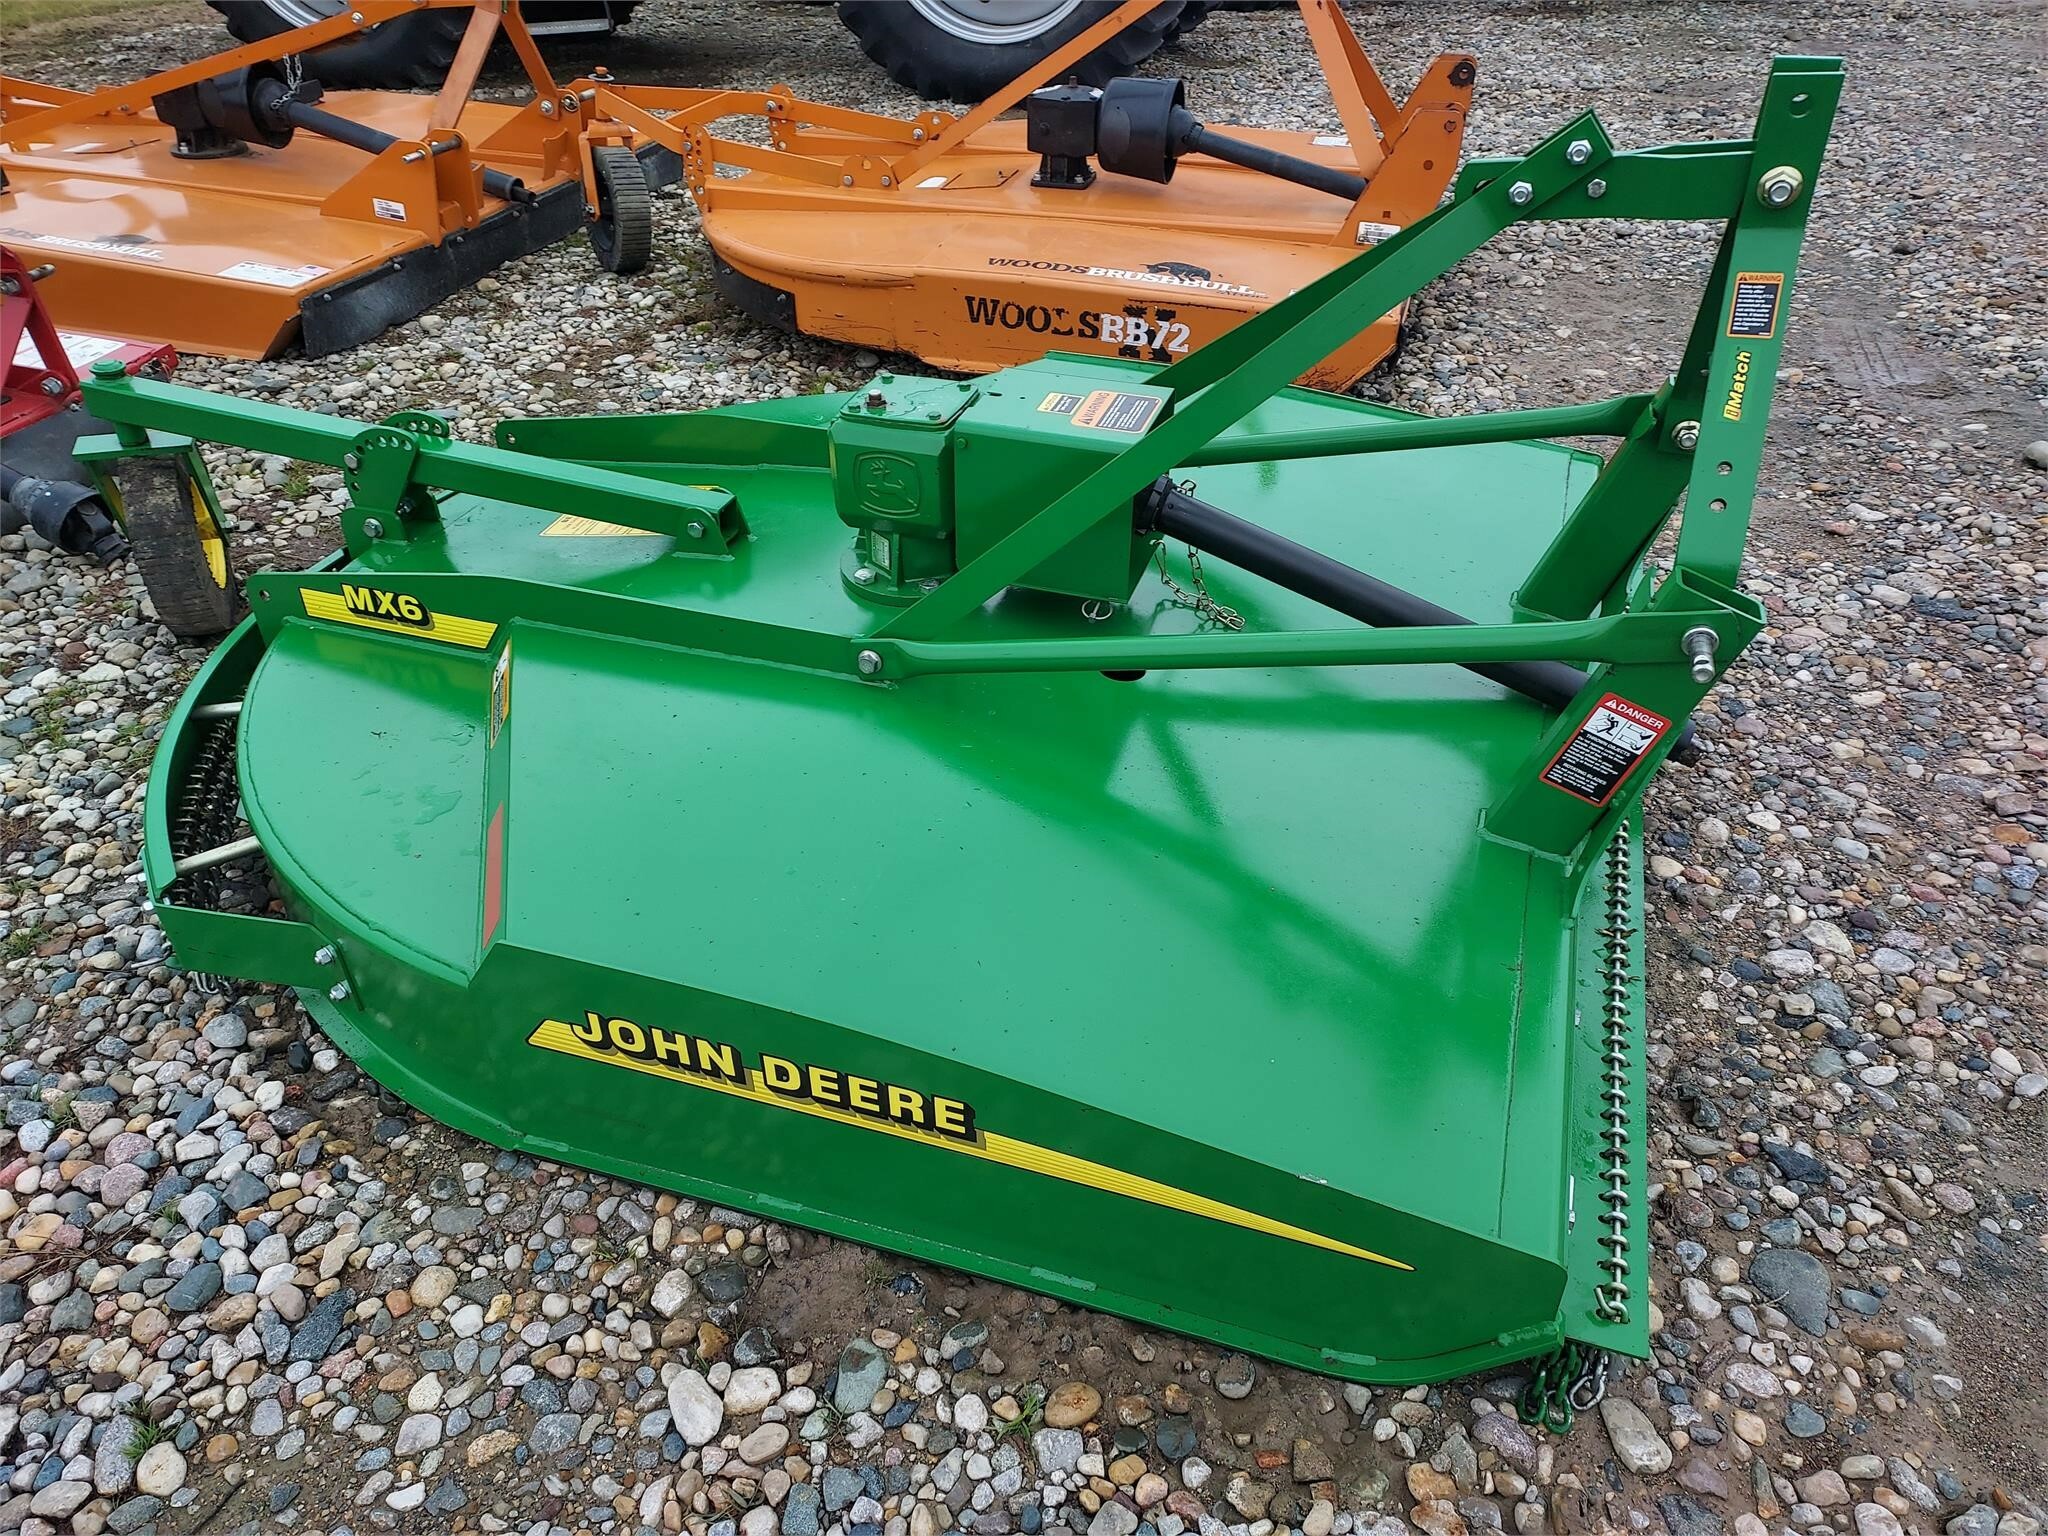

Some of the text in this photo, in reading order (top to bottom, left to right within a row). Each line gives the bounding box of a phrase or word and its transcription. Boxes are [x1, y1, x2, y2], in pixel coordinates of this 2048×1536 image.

[988, 257, 1256, 295] WOODS BRUSHBULL
[341, 583, 429, 626] MX6
[1616, 703, 1664, 730] DANGER
[571, 1010, 974, 1141] JOHN DEERE
